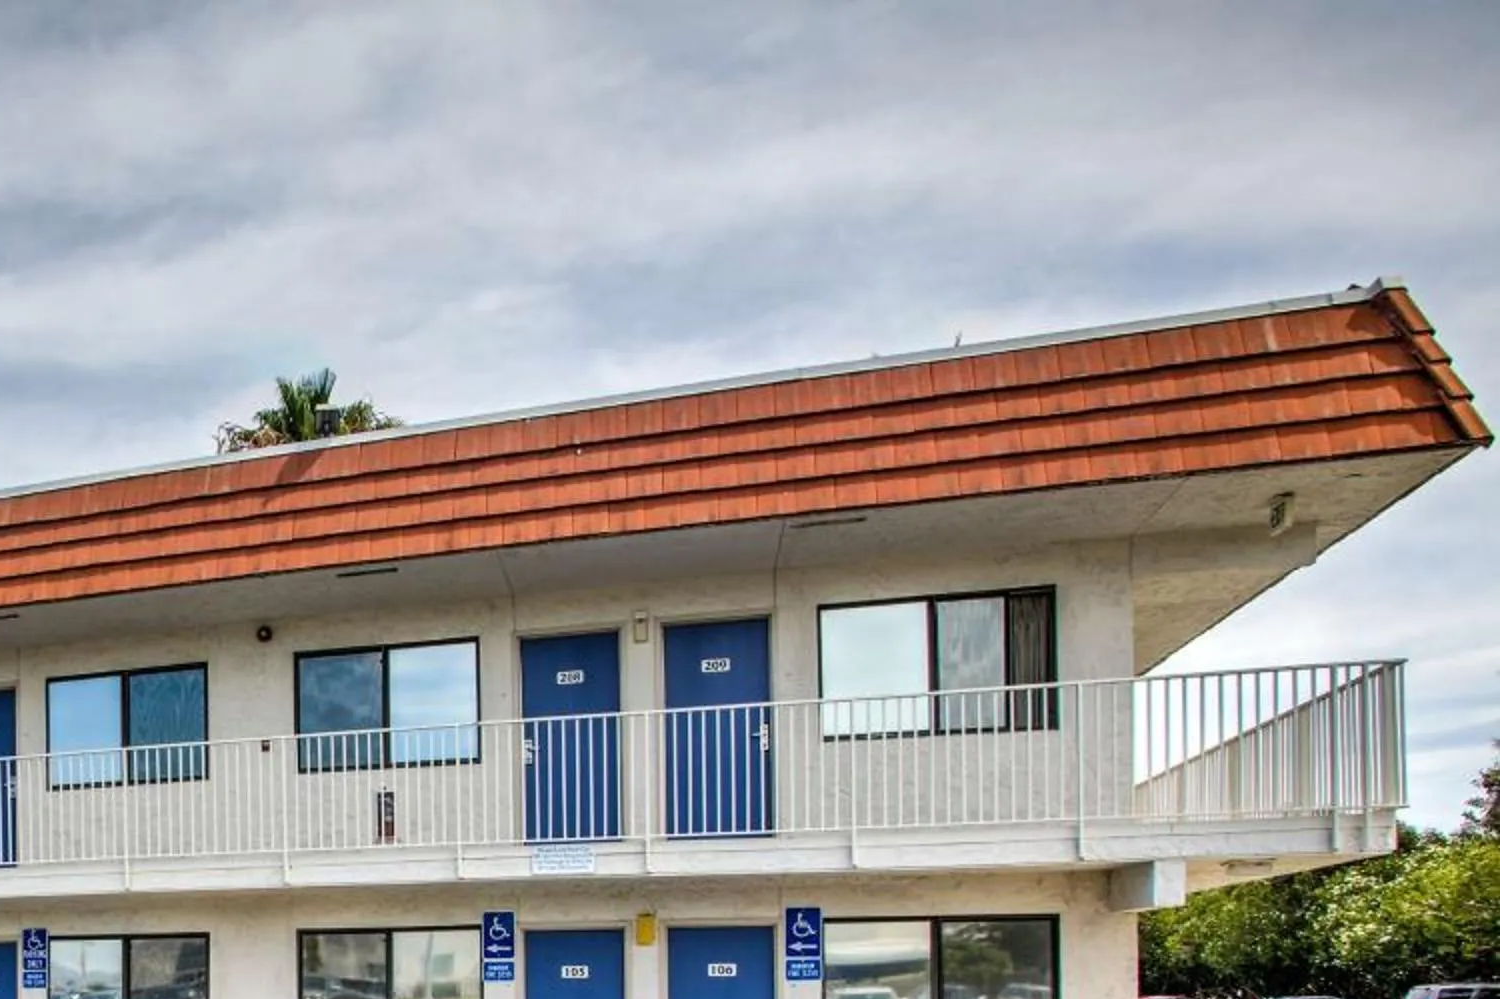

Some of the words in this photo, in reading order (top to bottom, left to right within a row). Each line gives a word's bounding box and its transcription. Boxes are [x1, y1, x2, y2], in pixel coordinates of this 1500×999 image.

[704, 659, 728, 671] 209
[564, 966, 586, 977] 105
[710, 965, 734, 975] 106
